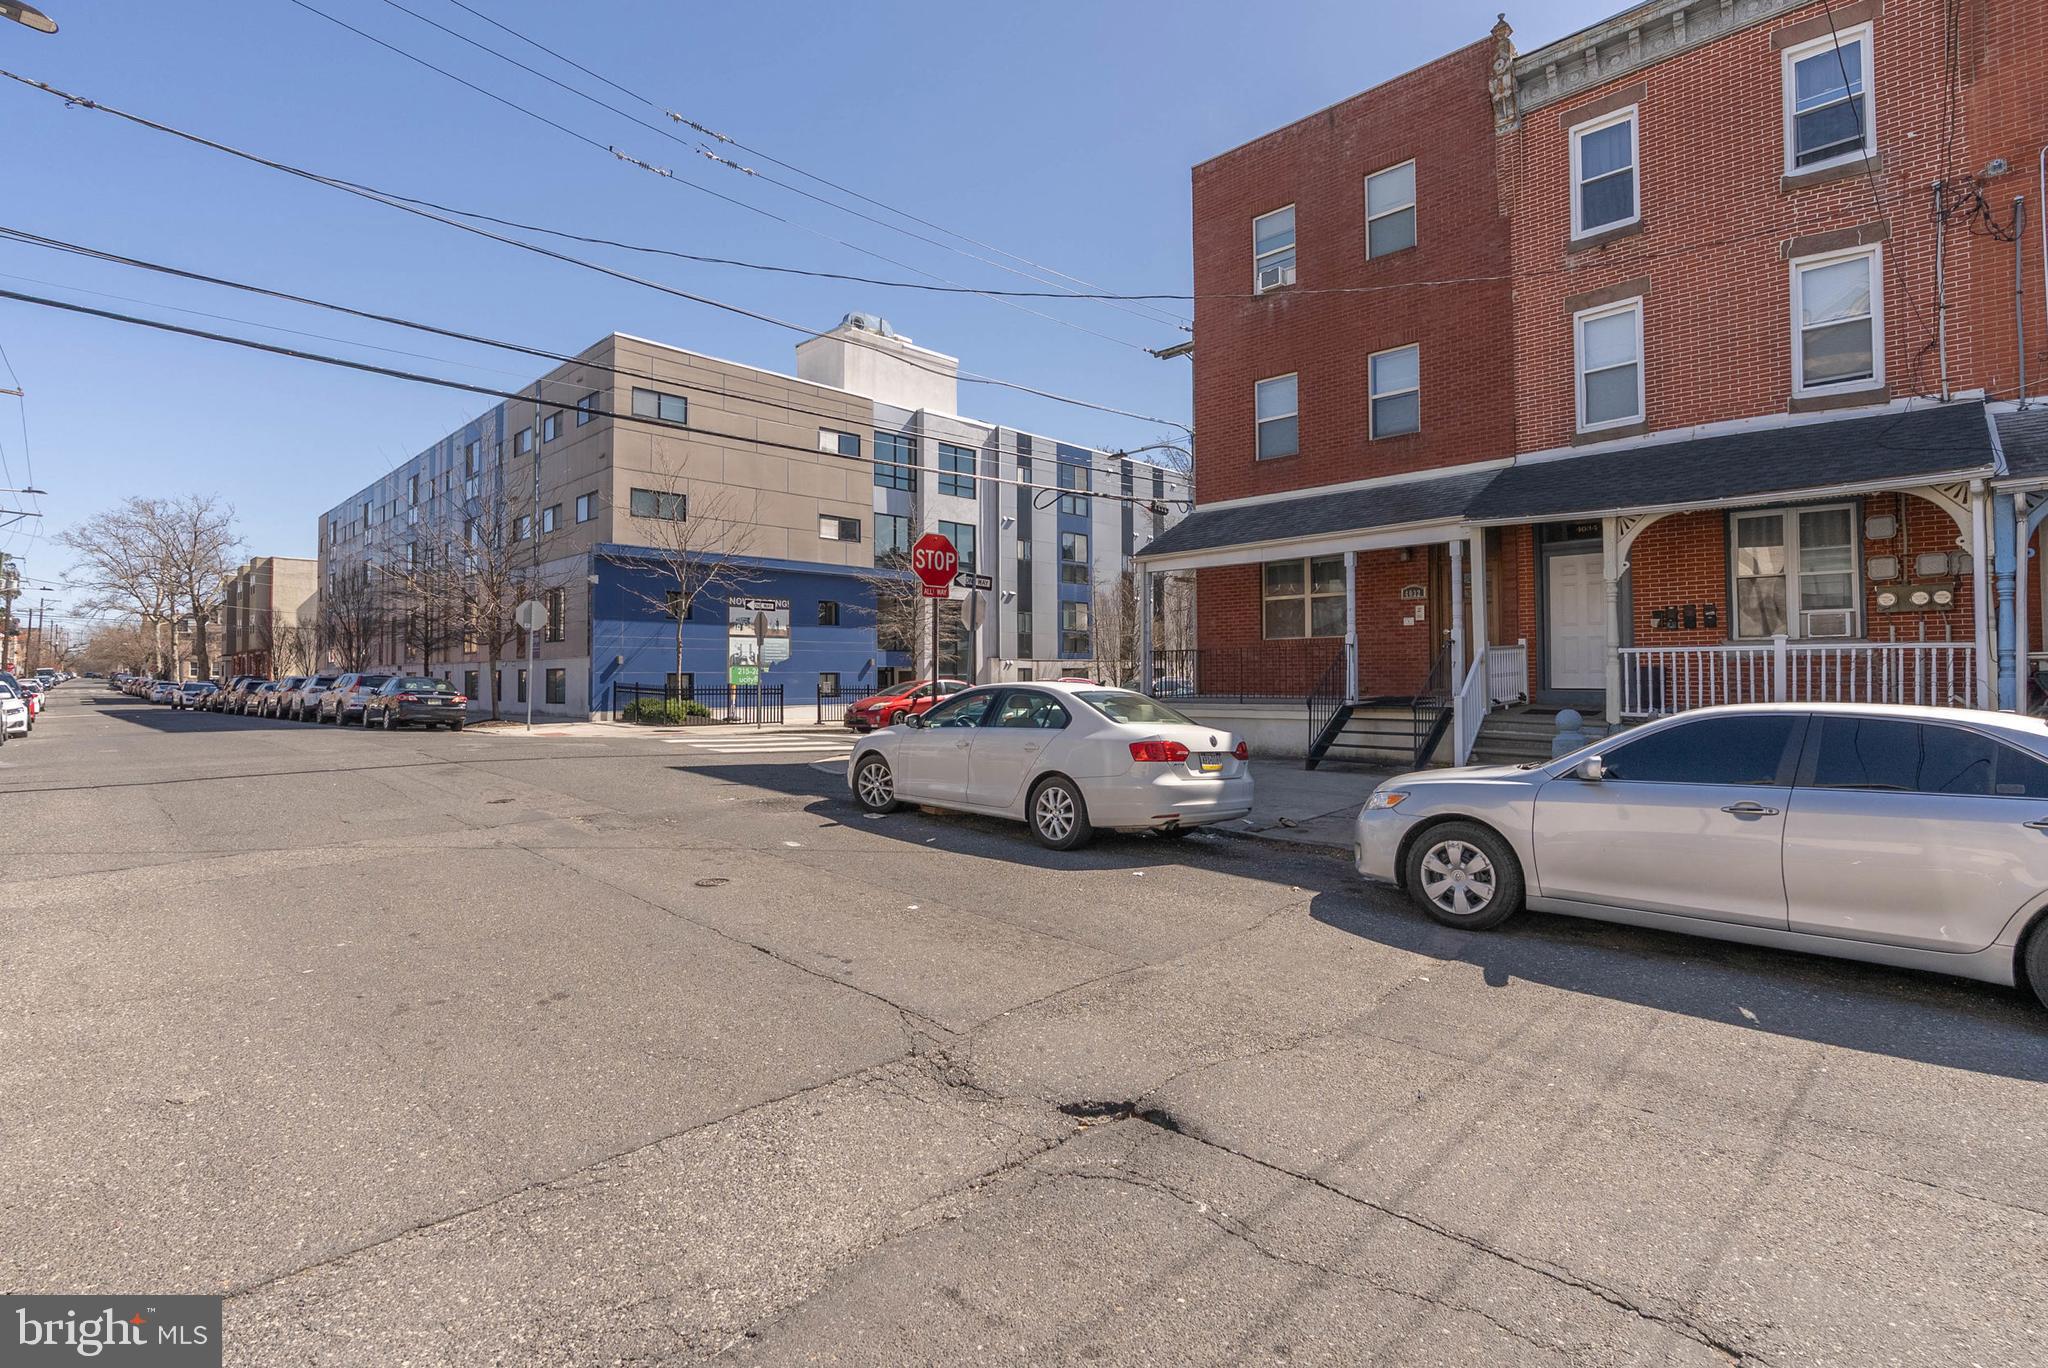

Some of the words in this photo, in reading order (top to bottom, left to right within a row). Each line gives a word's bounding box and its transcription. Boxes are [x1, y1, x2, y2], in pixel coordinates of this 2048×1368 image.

[915, 548, 956, 571] STOP
[966, 577, 975, 585] ON
[924, 587, 933, 595] ALL
[936, 588, 947, 596] WAY
